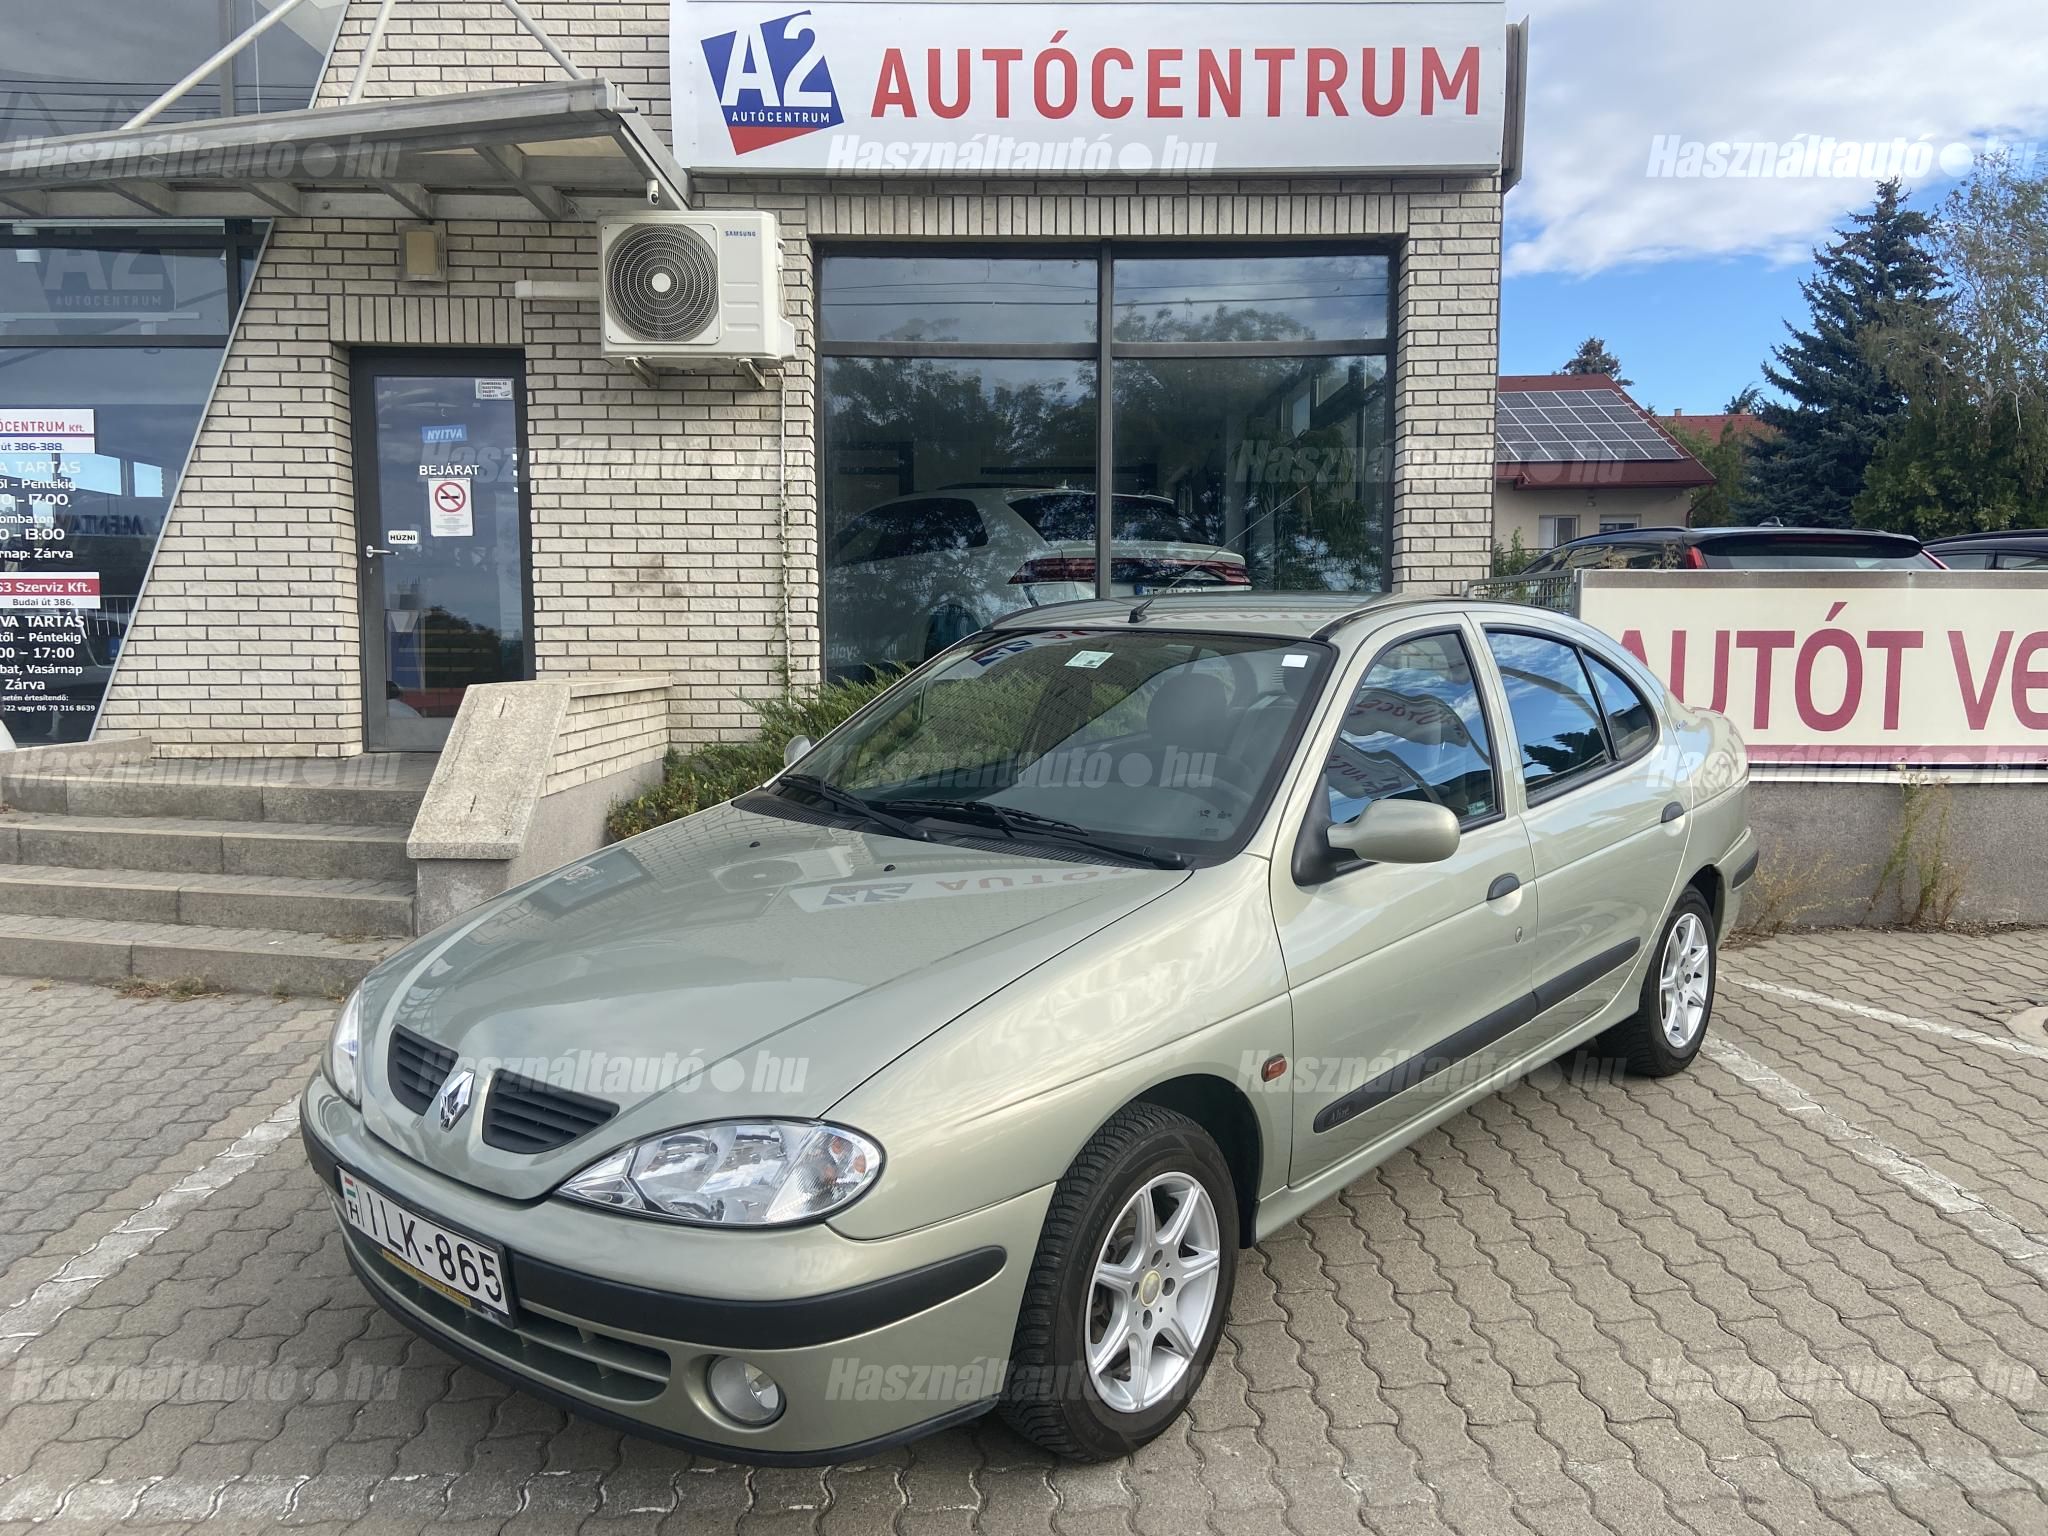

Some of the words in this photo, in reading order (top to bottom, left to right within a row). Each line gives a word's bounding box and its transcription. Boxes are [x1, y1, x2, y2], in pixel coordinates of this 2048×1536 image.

[720, 14, 832, 107] A2
[871, 30, 1480, 119] AUTÓCENTRUM
[732, 109, 830, 123] AUTÓCENTRUM
[69, 424, 85, 432] Kft.
[427, 428, 463, 441] NYITVA
[14, 442, 65, 451] 386-388.
[419, 462, 480, 476] BEJÁRAT
[25, 528, 65, 540] 13:00
[33, 547, 74, 559] Zárva
[15, 581, 64, 593] Szerviz
[67, 582, 92, 593] Kft.
[12, 598, 39, 606] Budai
[41, 598, 51, 606] út
[54, 598, 75, 606] 386.
[25, 611, 85, 628] TARTÁS
[28, 631, 82, 644] Péntekig
[33, 647, 75, 659] 17:00
[26, 663, 83, 676] Vasárnap
[5, 677, 46, 690] Zárva
[348, 1200, 360, 1225] H
[367, 1191, 502, 1303] ILK-865
